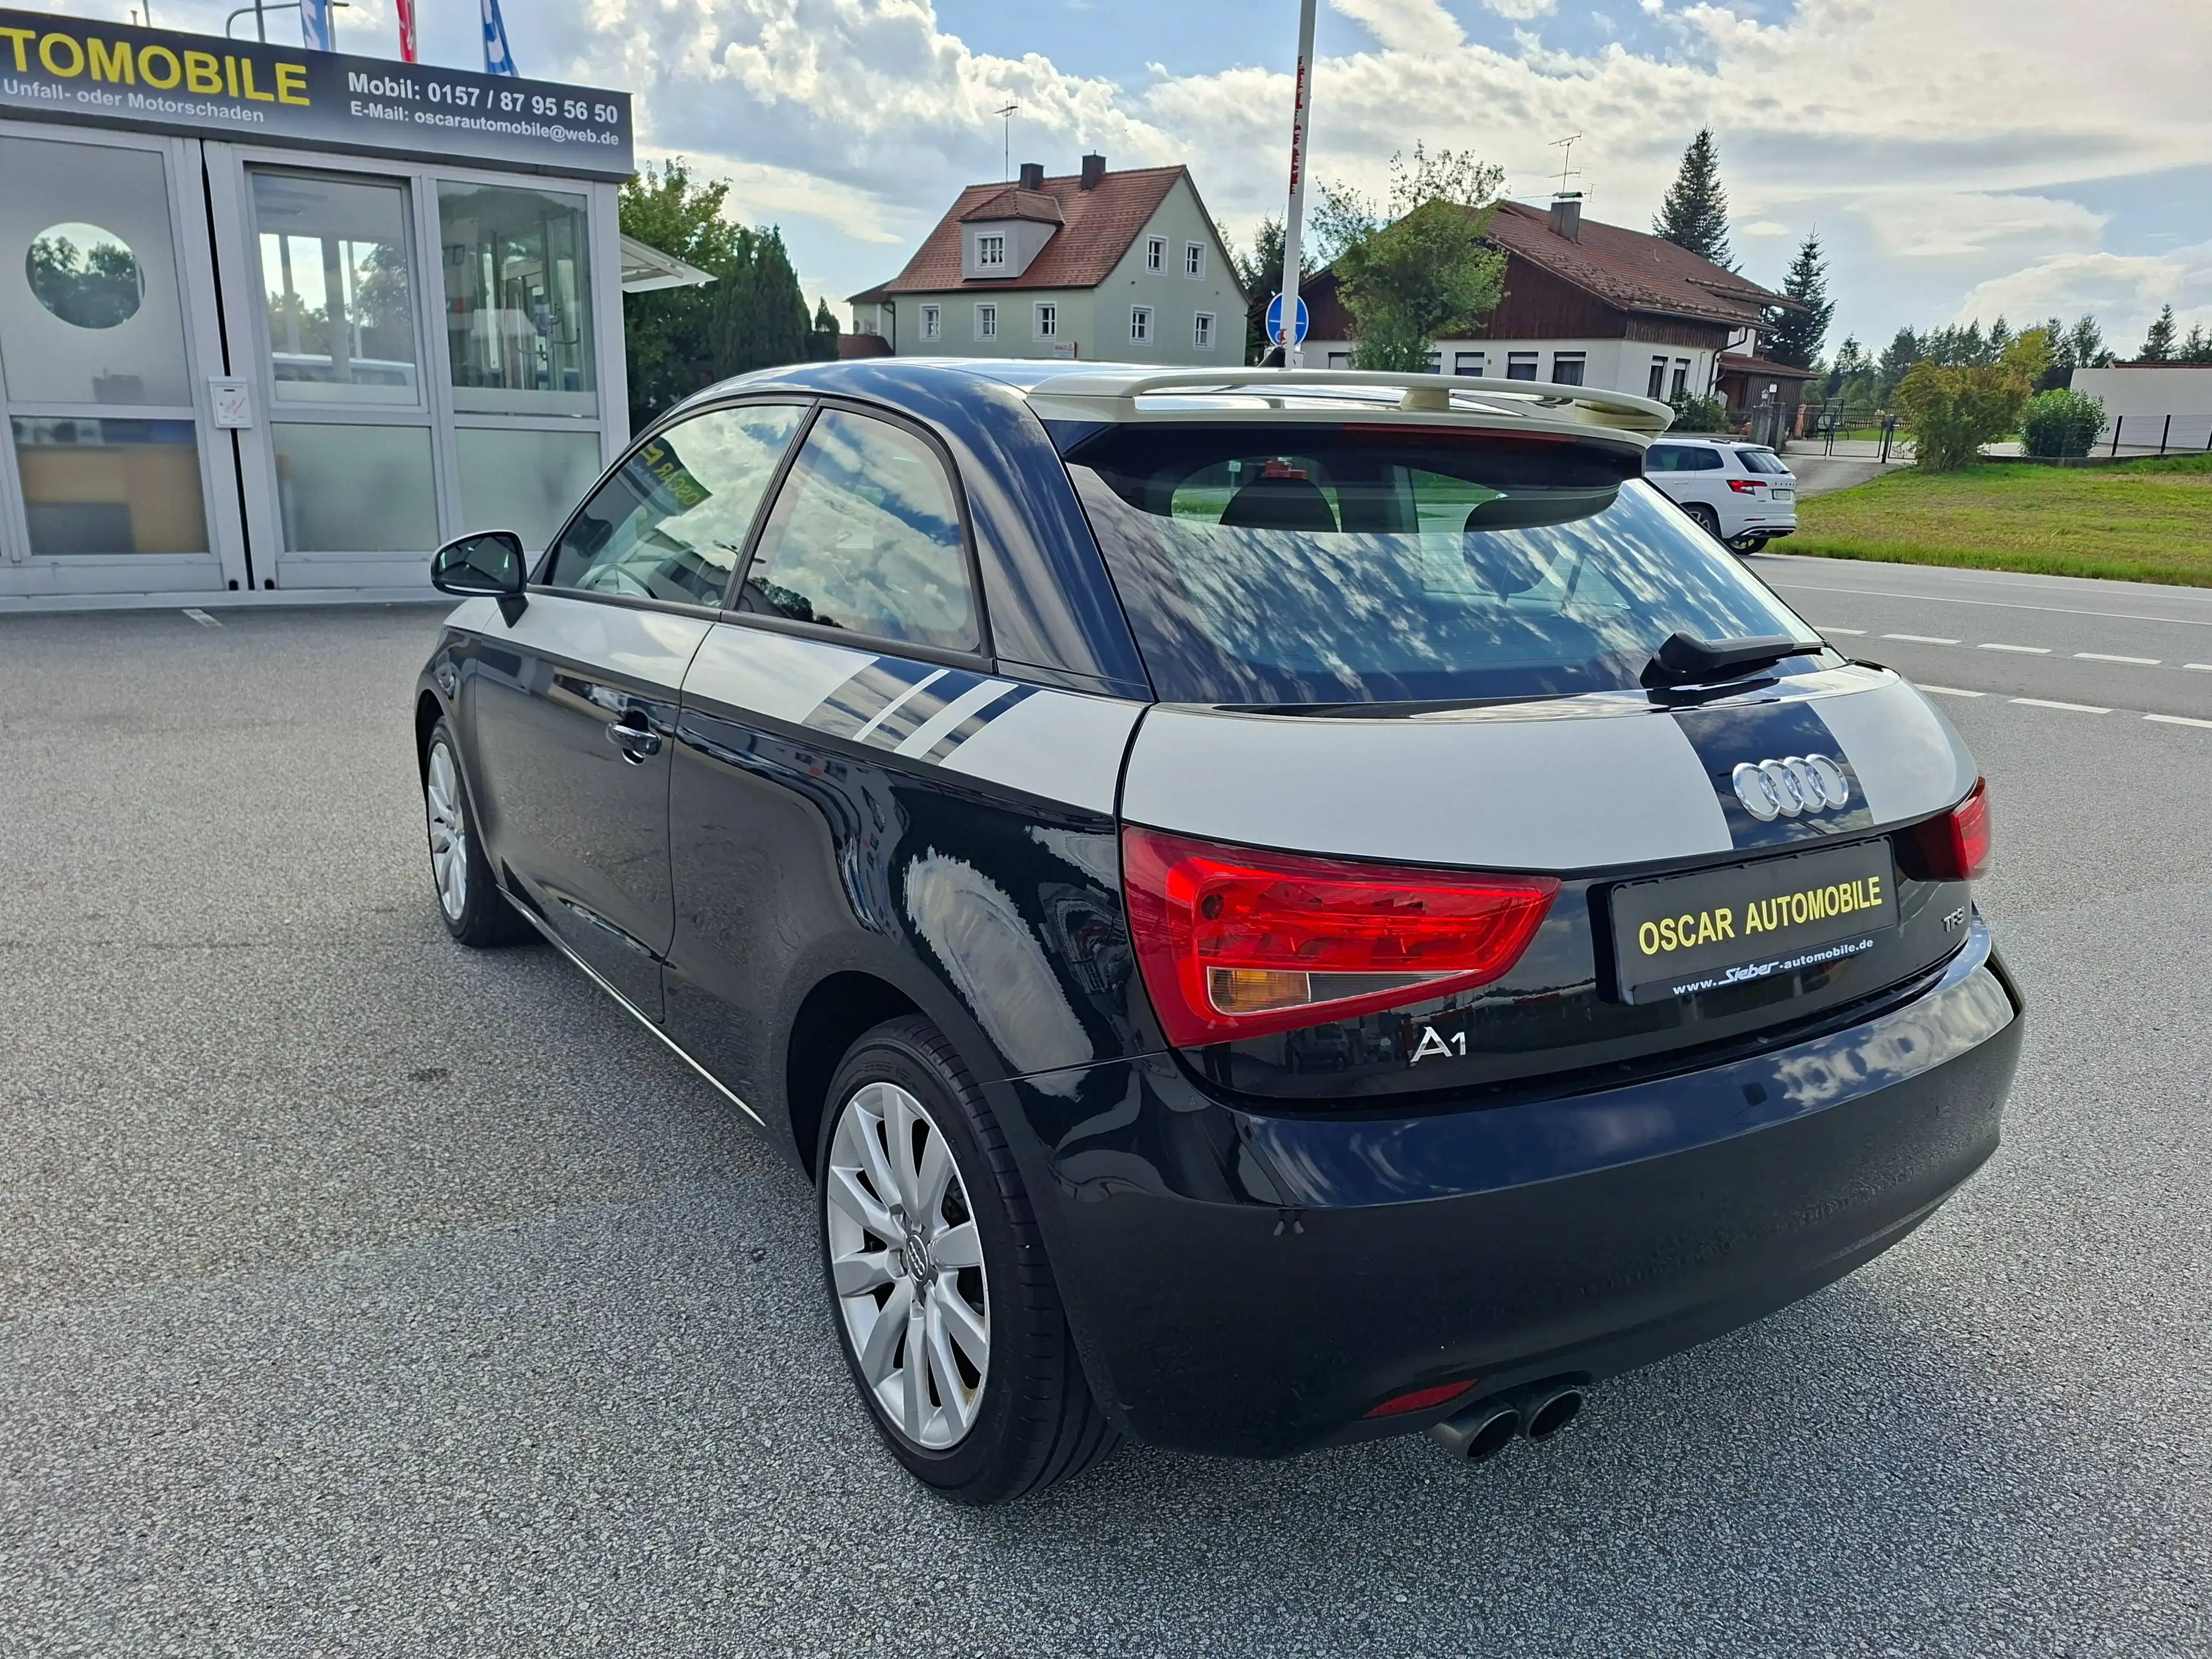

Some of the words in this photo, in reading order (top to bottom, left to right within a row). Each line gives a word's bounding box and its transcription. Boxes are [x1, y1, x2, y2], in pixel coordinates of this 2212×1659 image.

[0, 27, 310, 106] TOMOBILE
[3, 78, 71, 100] Unfall-
[77, 89, 122, 106] oder
[128, 93, 264, 123] Motorschaden
[349, 71, 420, 100] Mobil:
[427, 82, 480, 107] 0157
[487, 90, 494, 109] /
[500, 92, 525, 112] 87
[532, 96, 557, 116] 95
[564, 100, 588, 120] 56
[594, 104, 618, 123] 50
[350, 100, 409, 122] E-Mail:
[414, 111, 619, 146] oscarautomobile@web.de
[1639, 907, 1736, 955] OSCAR
[1745, 876, 1883, 935] AUTOMOBILE
[1672, 939, 1873, 995] www.Sieber-automobile.de
[1410, 1026, 1466, 1063] A1
